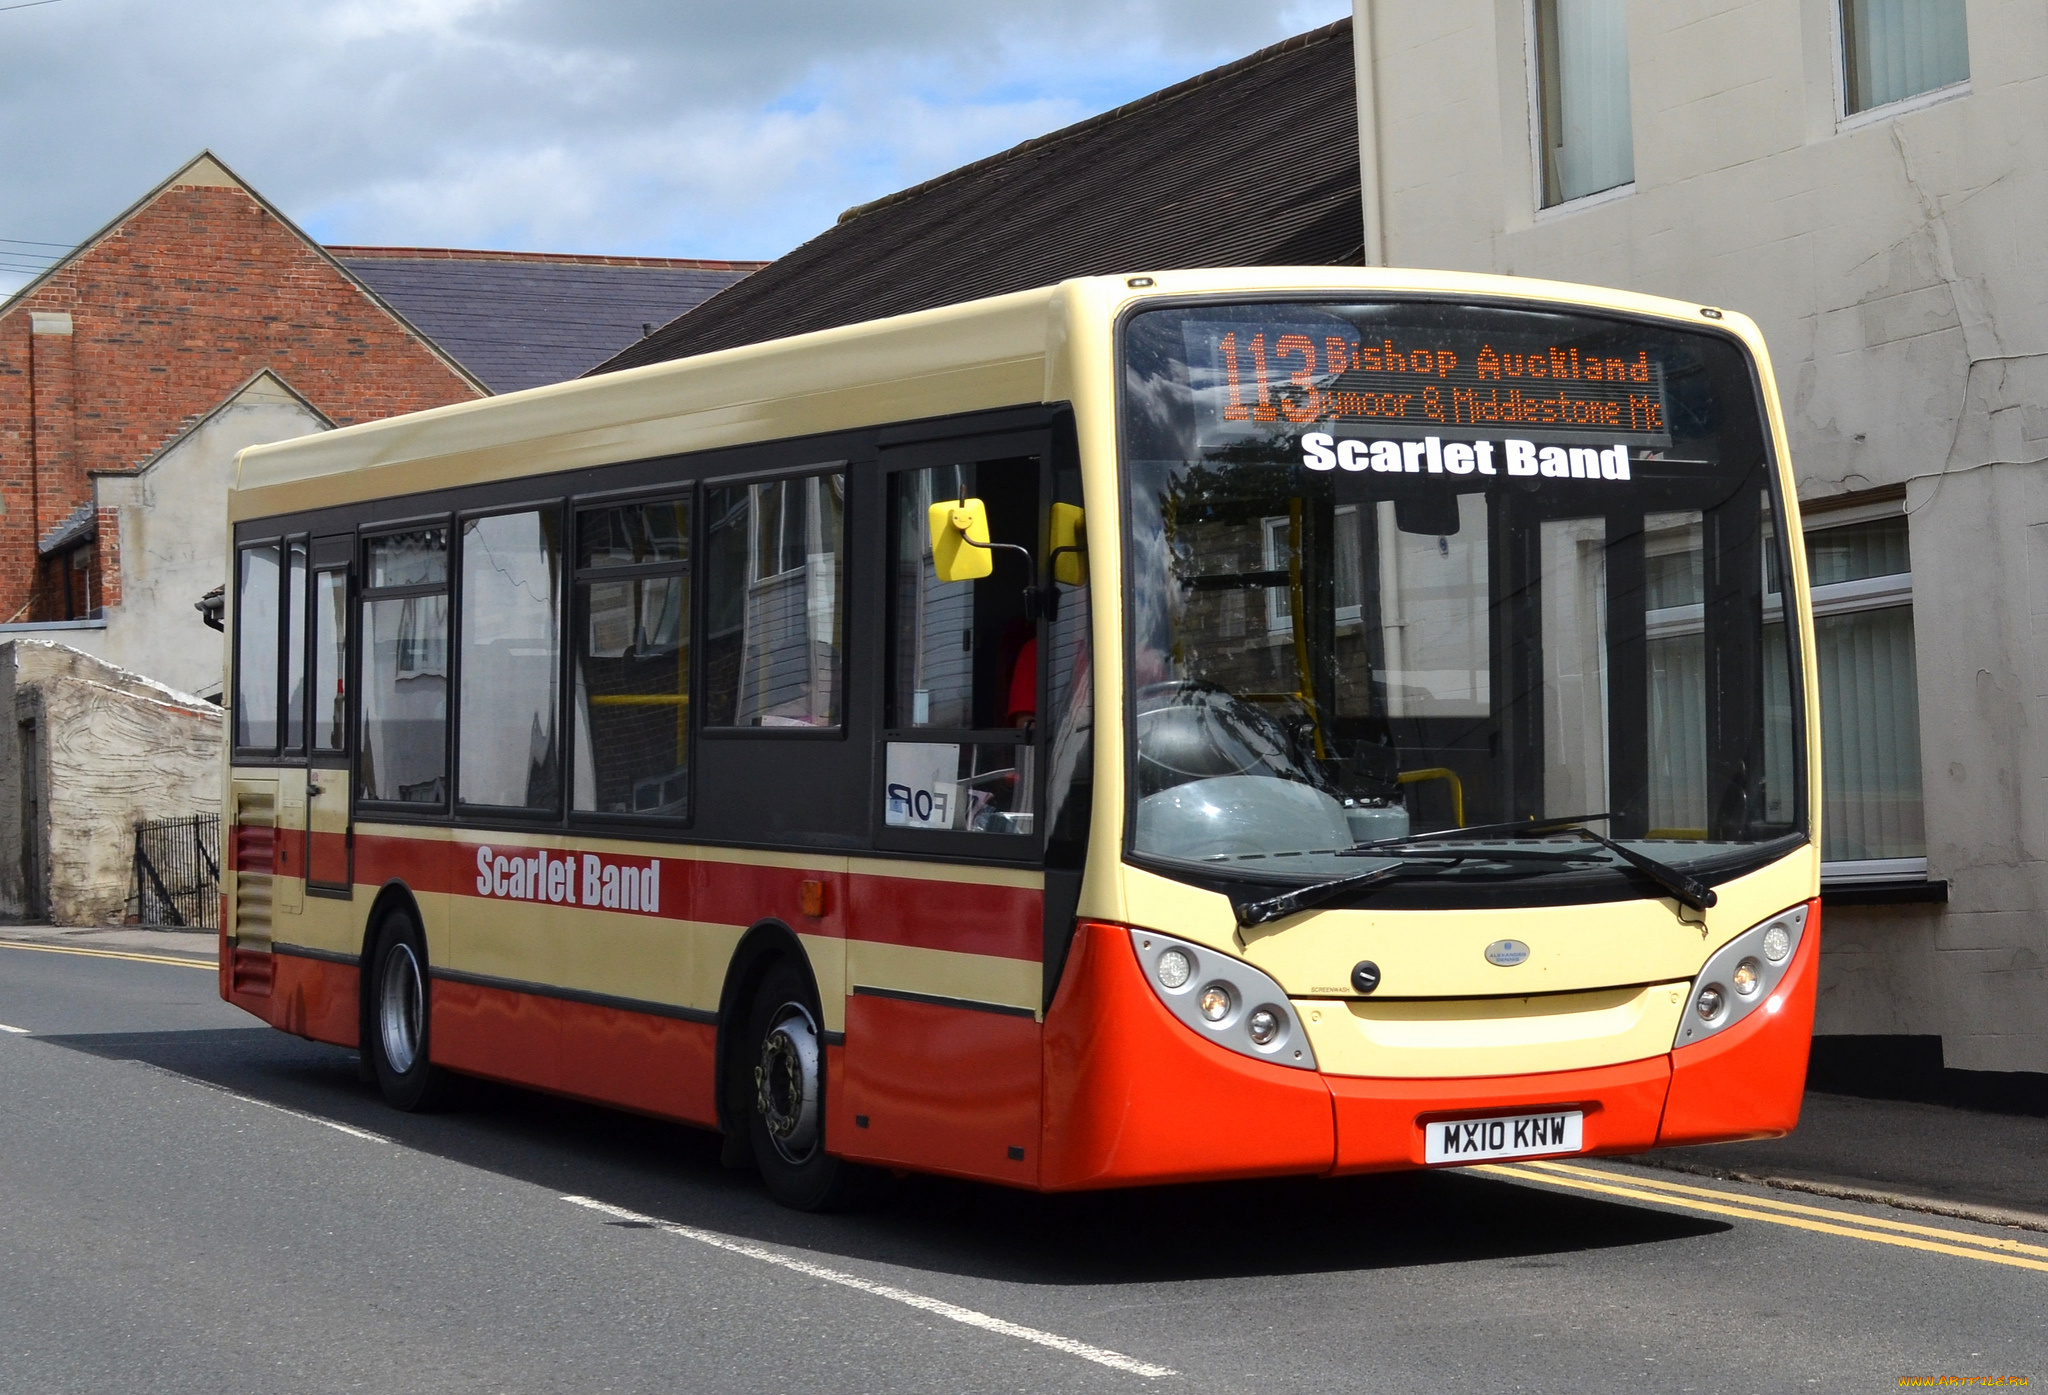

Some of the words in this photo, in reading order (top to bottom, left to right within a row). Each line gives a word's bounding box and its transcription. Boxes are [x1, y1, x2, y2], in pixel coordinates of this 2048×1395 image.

[1218, 332, 1320, 422] 113
[1325, 336, 1457, 378] Bishop
[1477, 343, 1649, 382] Auckland
[1422, 386, 1445, 423] &
[1453, 387, 1621, 424] Middlestone
[1301, 432, 1497, 476] Scarlet
[1507, 439, 1632, 481] Band
[476, 845, 576, 904] Scarlet
[582, 854, 660, 913] Band
[1444, 1121, 1505, 1155] MX10
[1514, 1116, 1566, 1149] KNW
